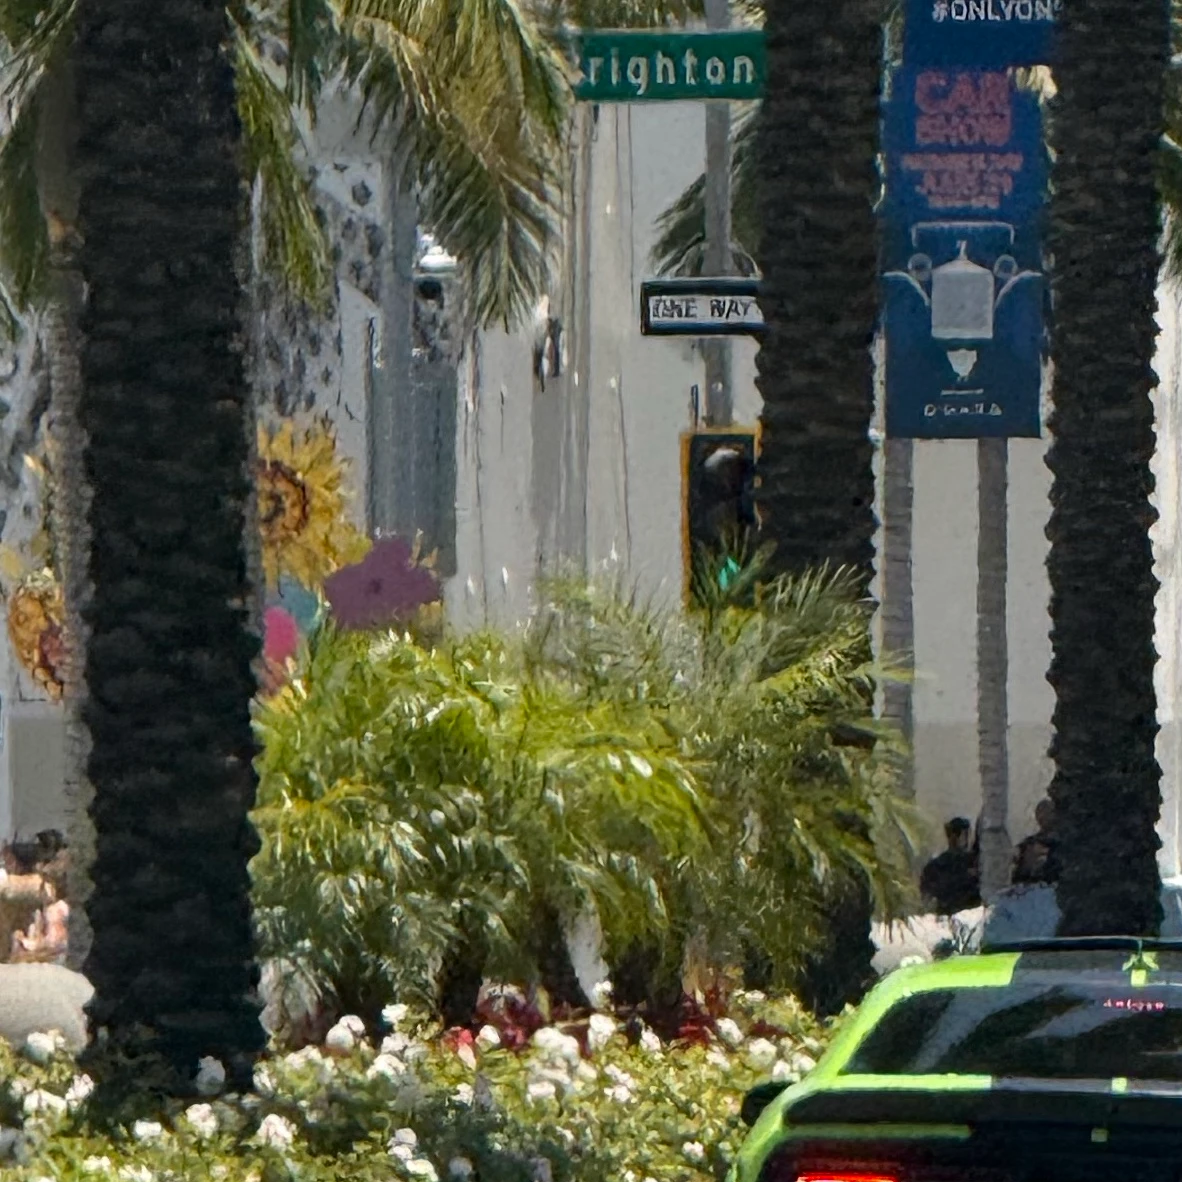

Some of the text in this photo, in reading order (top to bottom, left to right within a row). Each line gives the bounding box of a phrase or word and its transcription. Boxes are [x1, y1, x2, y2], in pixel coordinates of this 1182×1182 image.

[932, 0, 1062, 22] #ONLYON
[588, 47, 755, 96] righton
[710, 298, 753, 320] WAY
